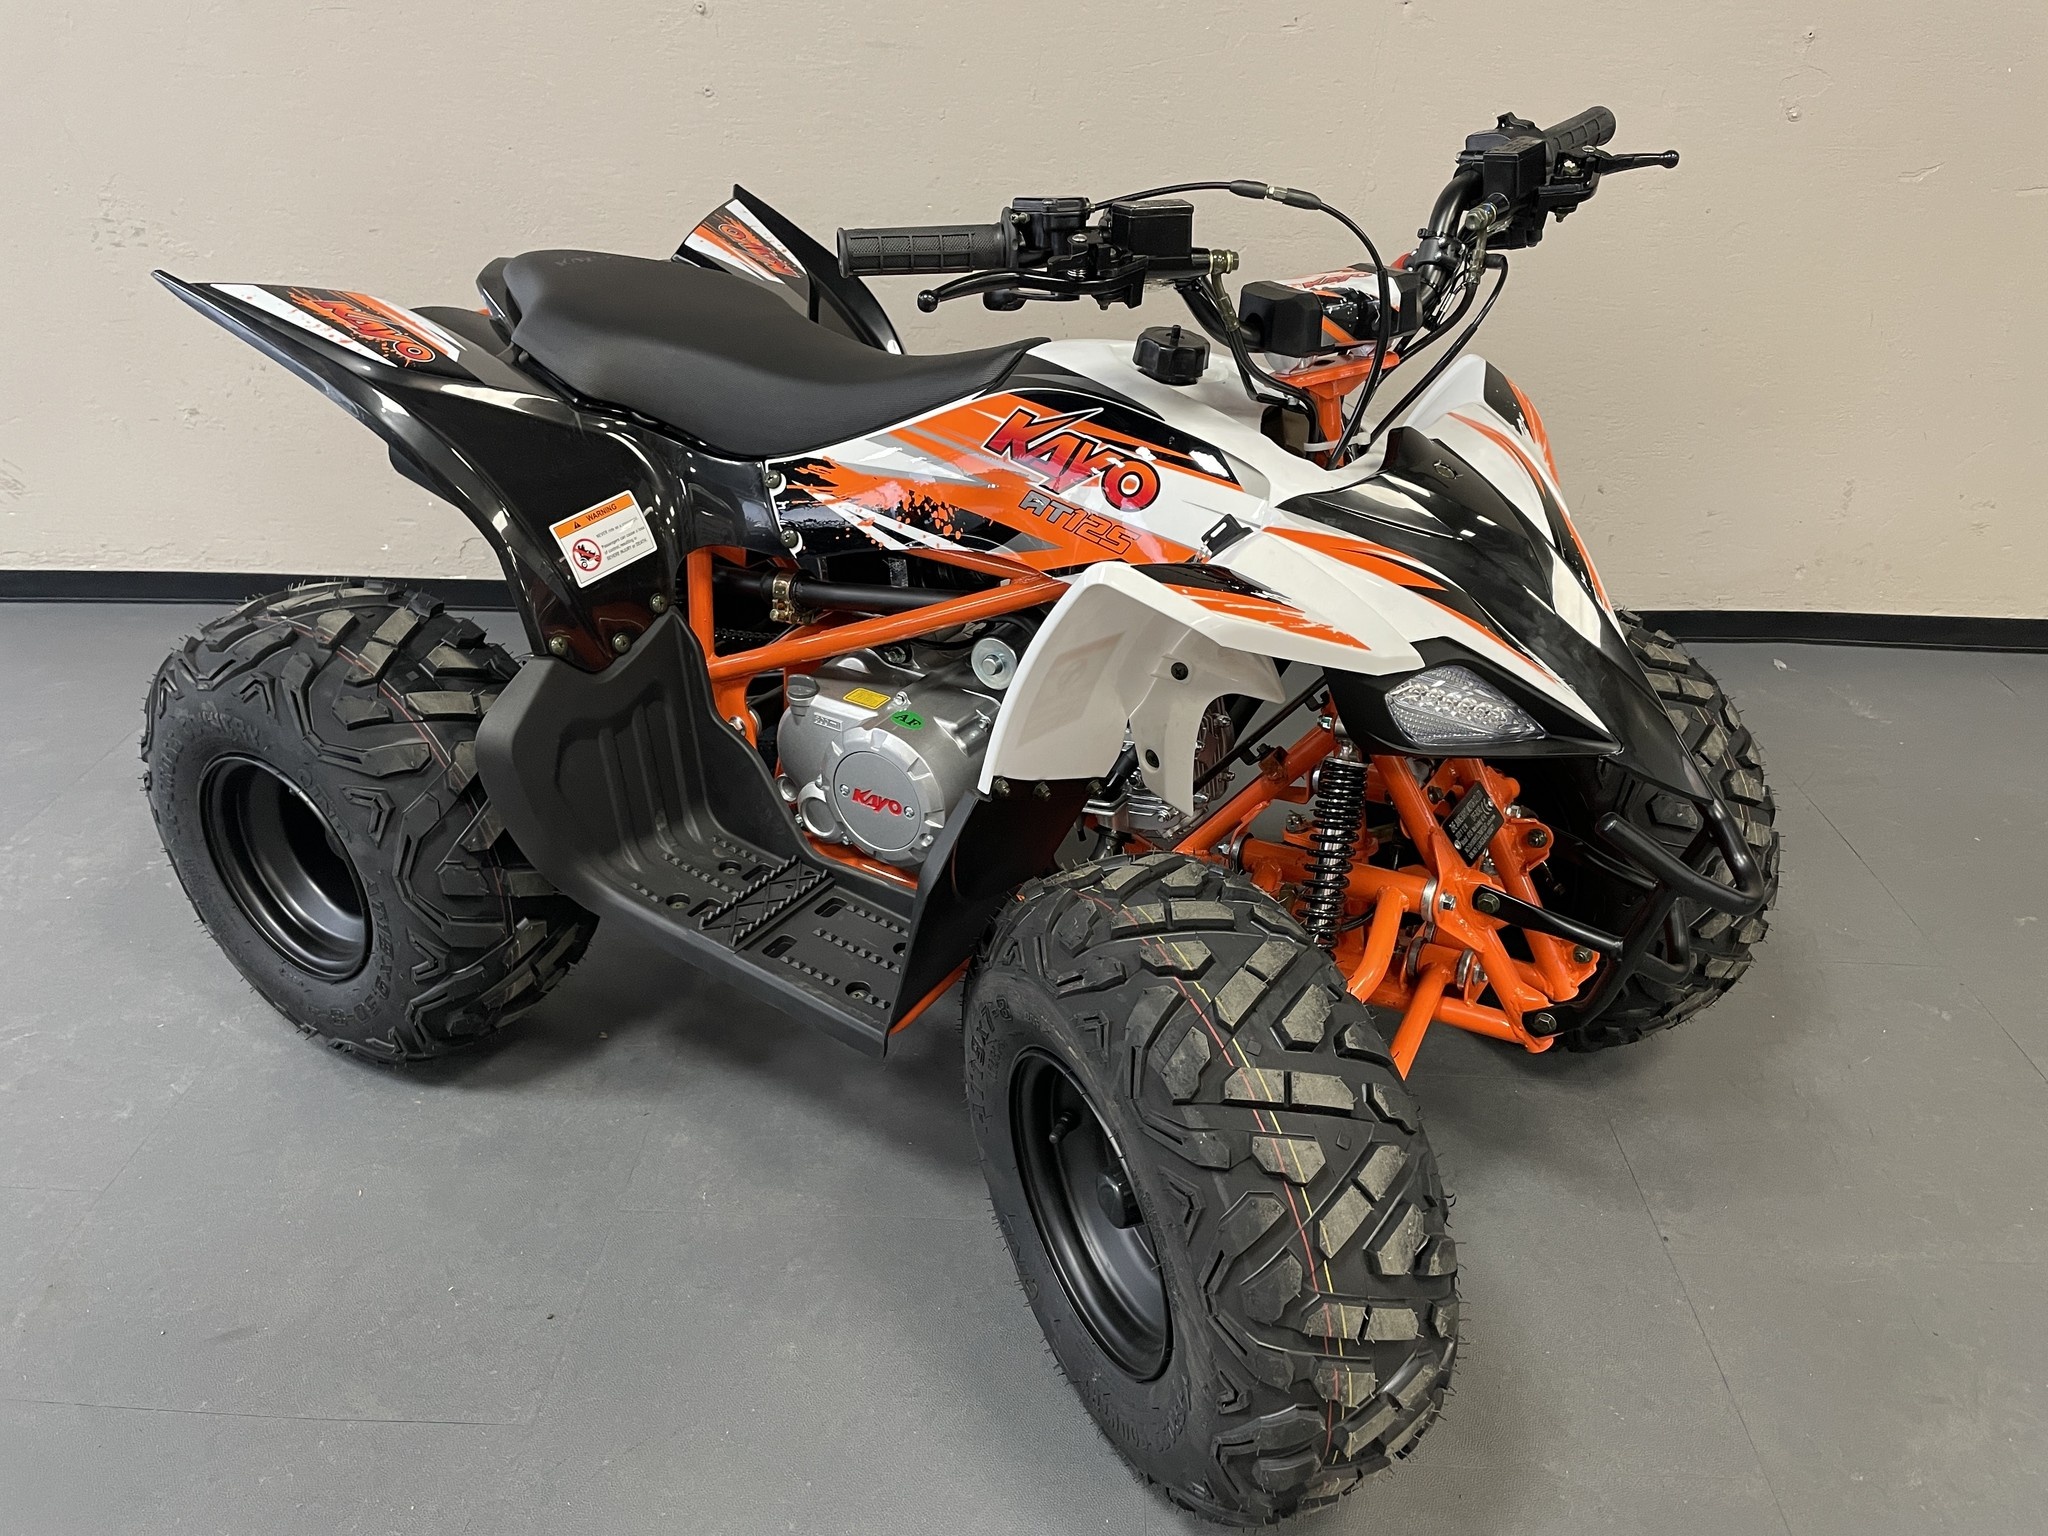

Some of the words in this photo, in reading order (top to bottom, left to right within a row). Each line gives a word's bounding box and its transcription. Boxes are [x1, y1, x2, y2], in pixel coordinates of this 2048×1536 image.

[982, 406, 1161, 513] KAYO
[586, 503, 617, 522] WARNING
[1018, 490, 1141, 555] AT125
[894, 712, 922, 728] AF
[851, 788, 902, 817] KAYO
